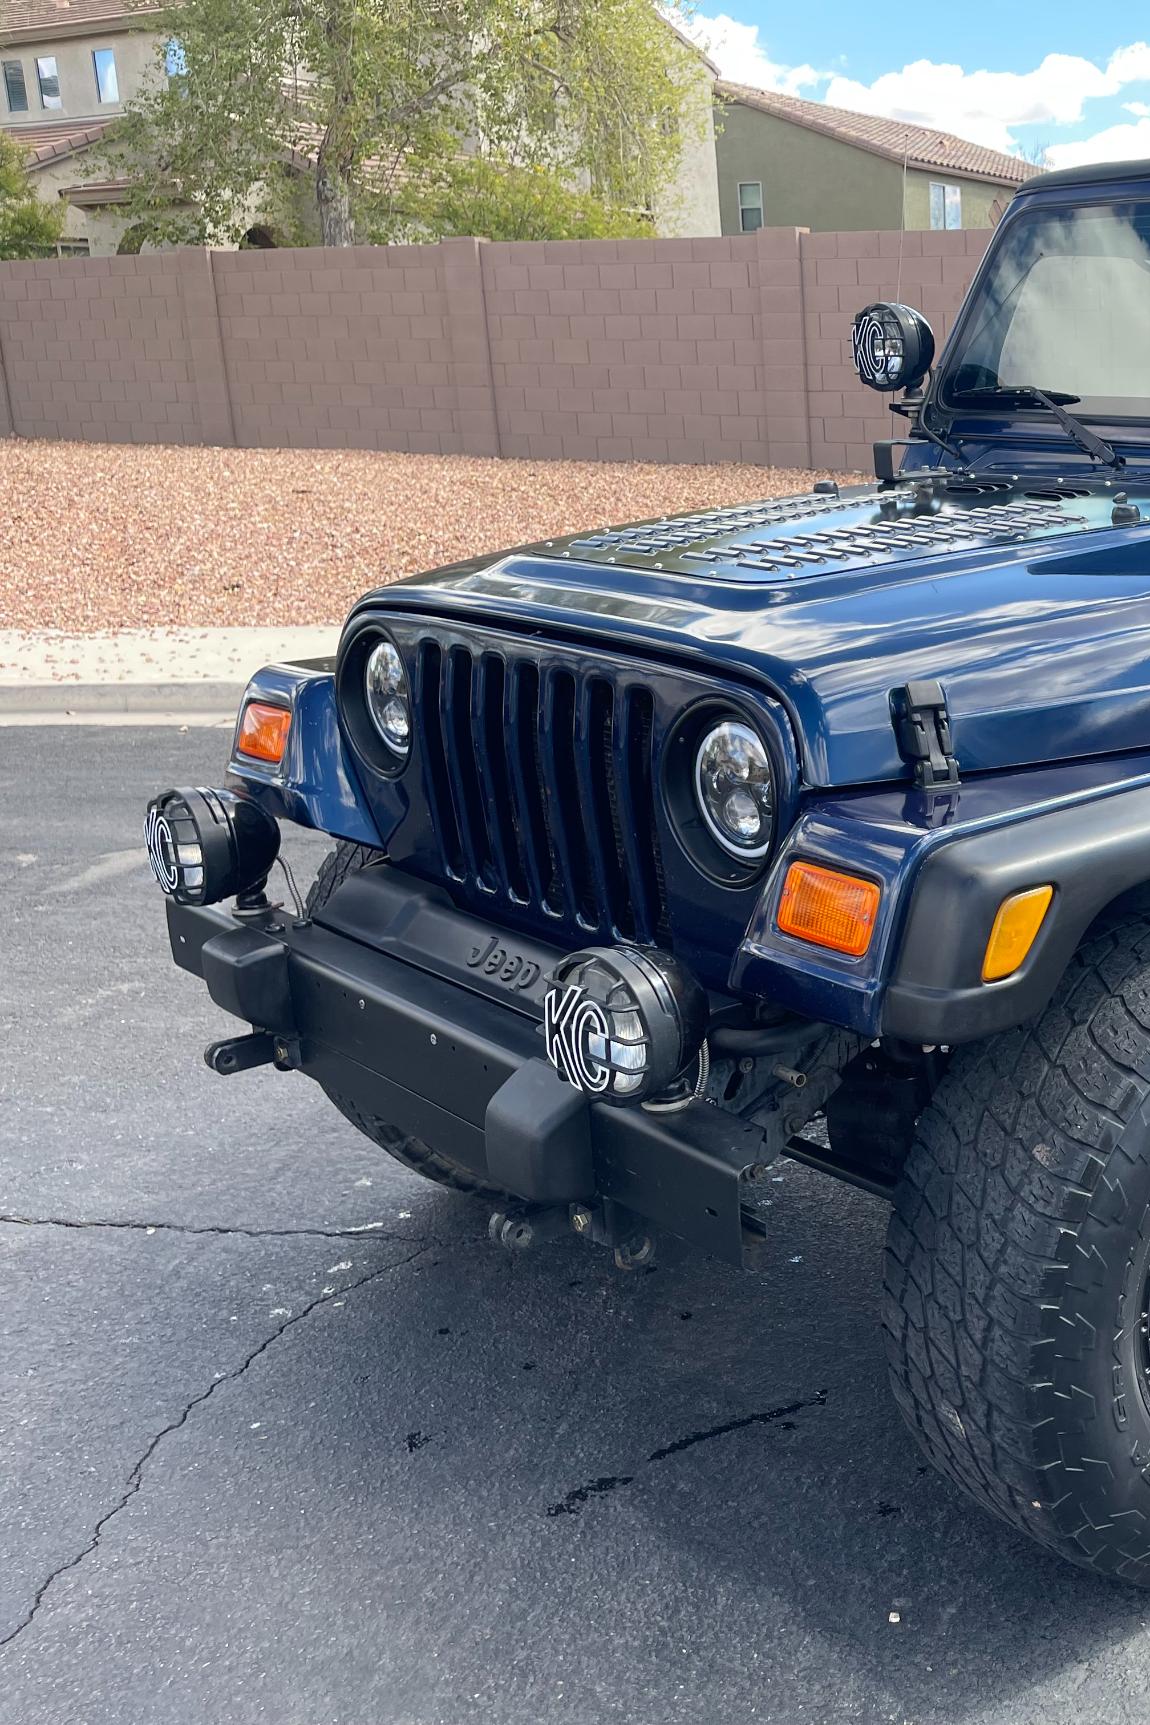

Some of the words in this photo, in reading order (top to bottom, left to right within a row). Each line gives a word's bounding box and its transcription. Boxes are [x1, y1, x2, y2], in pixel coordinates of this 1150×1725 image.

[852, 316, 886, 379] KC
[143, 808, 178, 893] KC
[466, 936, 541, 993] Jeep
[543, 984, 610, 1092] KC
